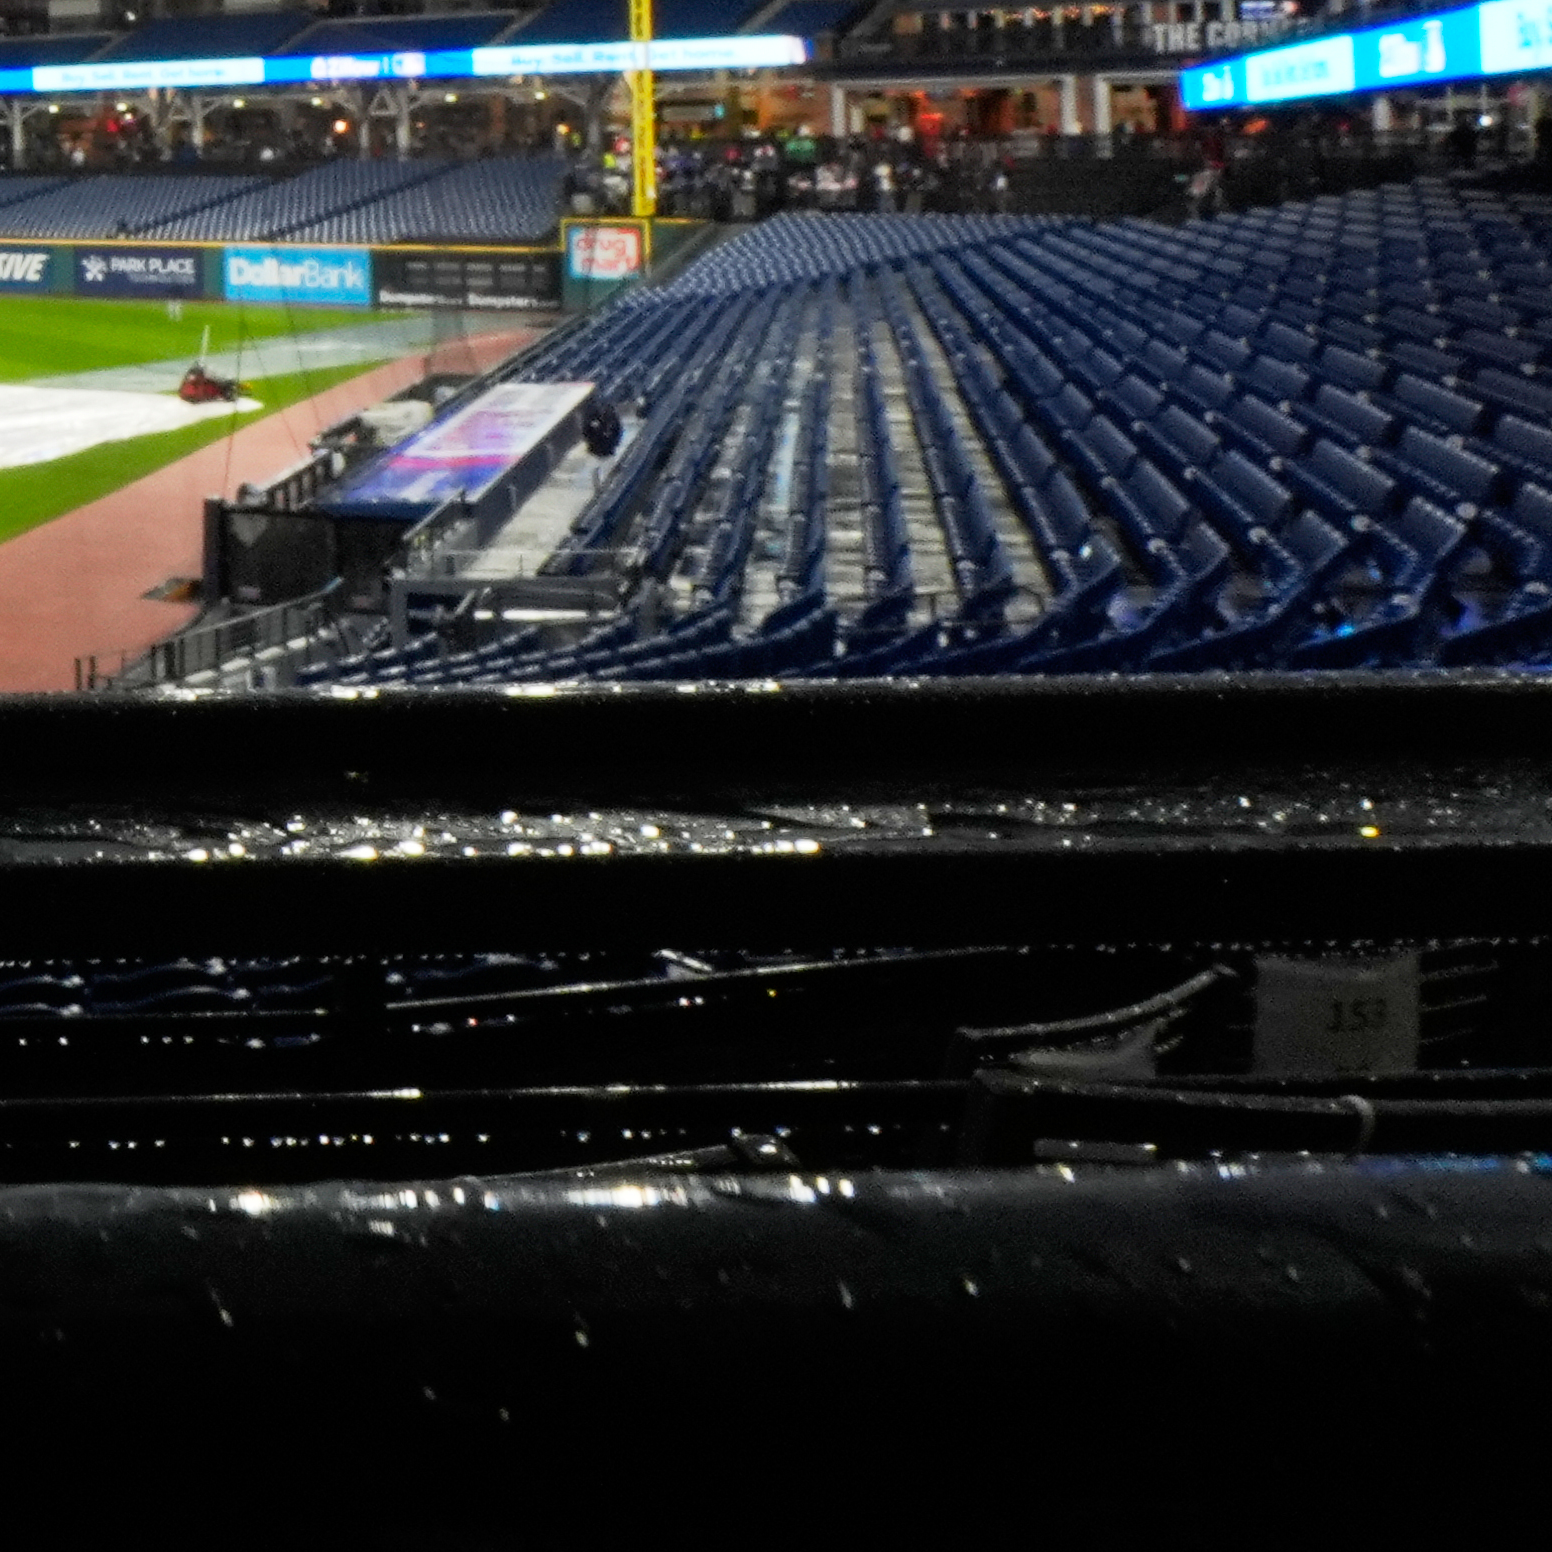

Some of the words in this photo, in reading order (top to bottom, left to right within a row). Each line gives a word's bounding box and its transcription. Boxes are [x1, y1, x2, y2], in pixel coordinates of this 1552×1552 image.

[1153, 22, 1194, 54] THE
[110, 256, 146, 272] PARK
[148, 257, 195, 275] PLACE
